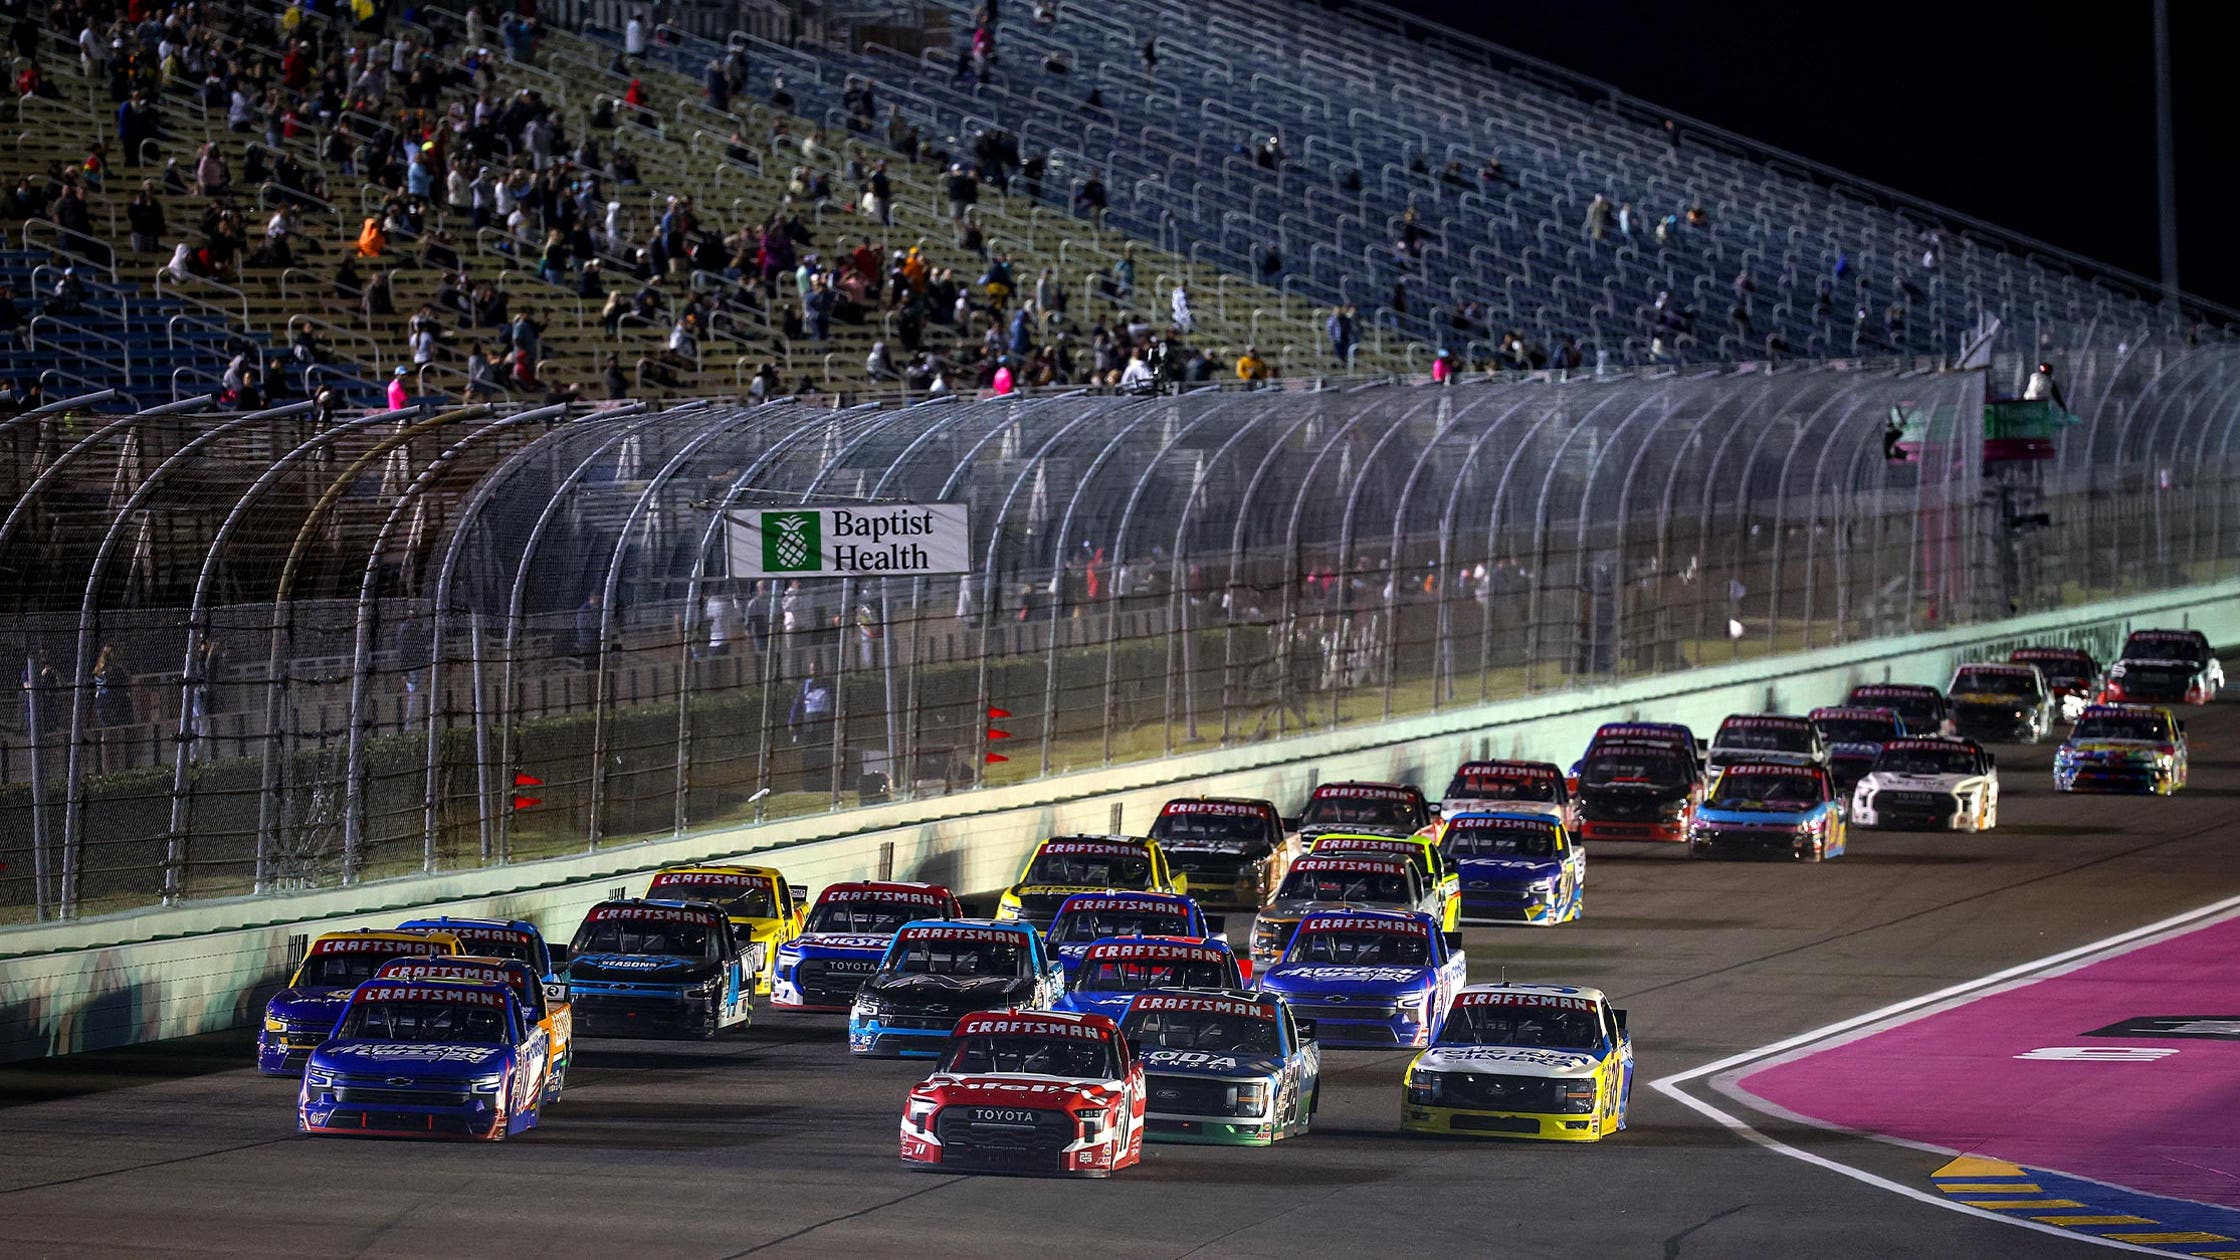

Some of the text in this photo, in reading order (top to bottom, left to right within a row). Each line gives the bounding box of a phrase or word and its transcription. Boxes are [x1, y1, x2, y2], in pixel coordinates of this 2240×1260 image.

[832, 508, 933, 544] Baptist
[833, 543, 930, 571] Health
[1857, 687, 1927, 698] CRAFTSMAN
[1813, 710, 1886, 722] CRAFTSMAN
[1728, 718, 1805, 730] CRAFTSMAN
[1602, 727, 1680, 739] CRAFTSMAN
[1889, 740, 1968, 753] CRAFTSMAN
[1464, 765, 1549, 778] CRAFTSMAN
[1731, 766, 1813, 777] CRAFTSMAN
[1321, 788, 1409, 800] CRAFTSMAN
[1169, 803, 1258, 815] CRAFTSMAN
[1456, 818, 1548, 832] CRAFTSMAN
[1045, 843, 1142, 857] CRAFTSMAN
[1321, 839, 1417, 854] CRAFTSMAN
[1297, 860, 1395, 874] CRAFTSMAN
[661, 874, 764, 889] CRAFTSMAN
[828, 891, 935, 905] CRAFTSMAN
[1073, 899, 1180, 914] CRAFTSMAN
[597, 908, 708, 924] CRAFTSMAN
[1310, 918, 1419, 934] CRAFTSMAN
[907, 928, 1020, 944] CRAFTSMAN
[323, 941, 440, 955] CRAFTSMAN
[1094, 945, 1217, 962] CRAFTSMAN
[829, 961, 876, 971] TOYOTA
[387, 966, 510, 983] CRAFTSMAN
[366, 988, 495, 1006] CRAFTSMAN
[1462, 993, 1588, 1010] CRAFTSMAN
[1138, 997, 1262, 1017] CRAFTSMAN
[966, 1020, 1099, 1039] CRAFTSMAN
[860, 1035, 872, 1045] 45
[277, 1043, 289, 1055] 19
[310, 1112, 327, 1124] 07
[975, 1108, 1034, 1122] TOYOTA
[915, 1143, 927, 1155] 11
